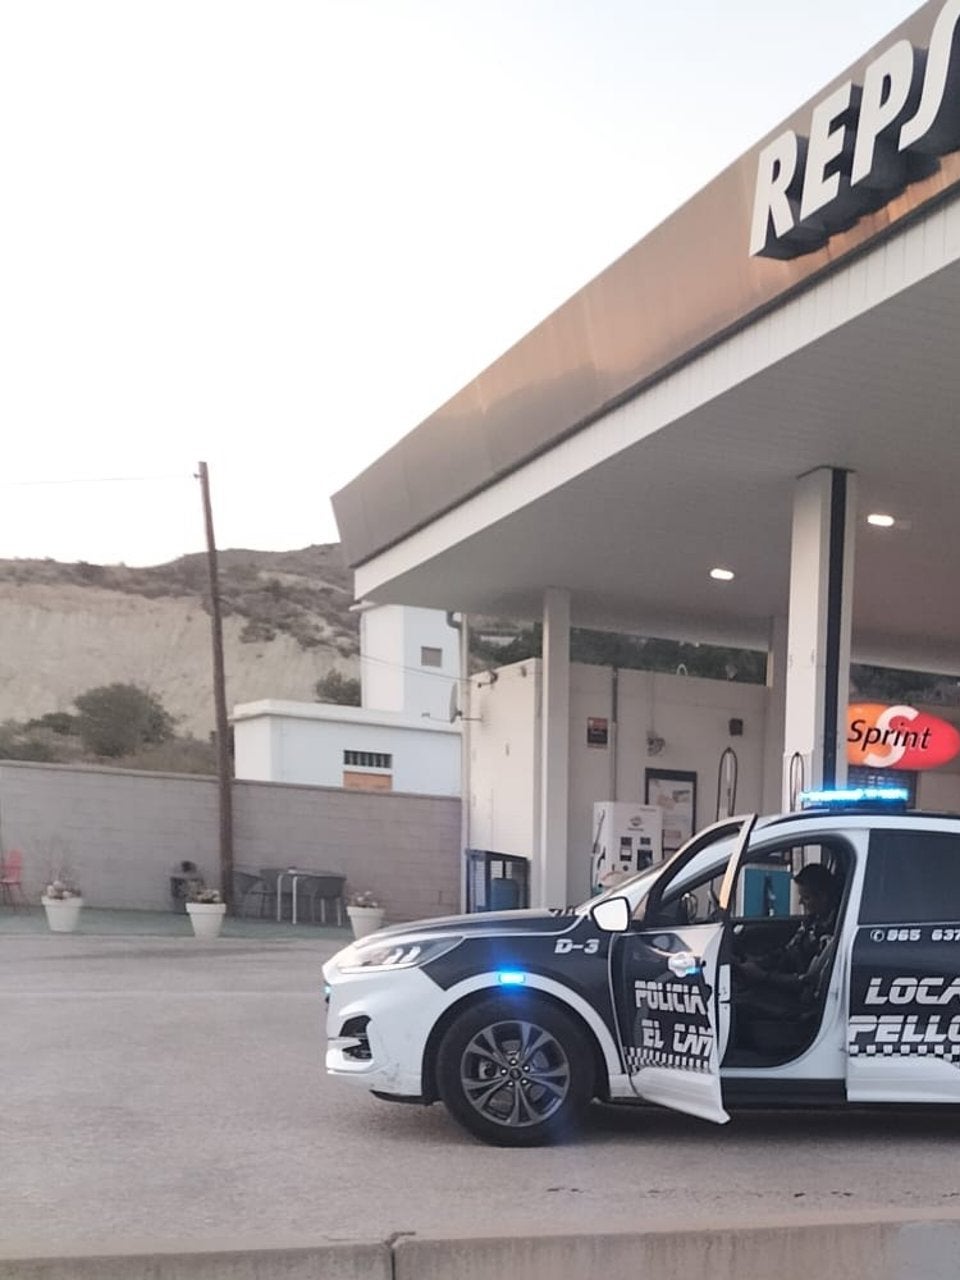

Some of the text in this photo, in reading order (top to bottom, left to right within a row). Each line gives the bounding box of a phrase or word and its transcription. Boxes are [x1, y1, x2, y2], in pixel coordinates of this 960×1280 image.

[847, 719, 932, 751] Sprint
[554, 938, 600, 954] D-3
[634, 980, 707, 1016] POLICIA
[641, 1019, 713, 1058] EL CAM
